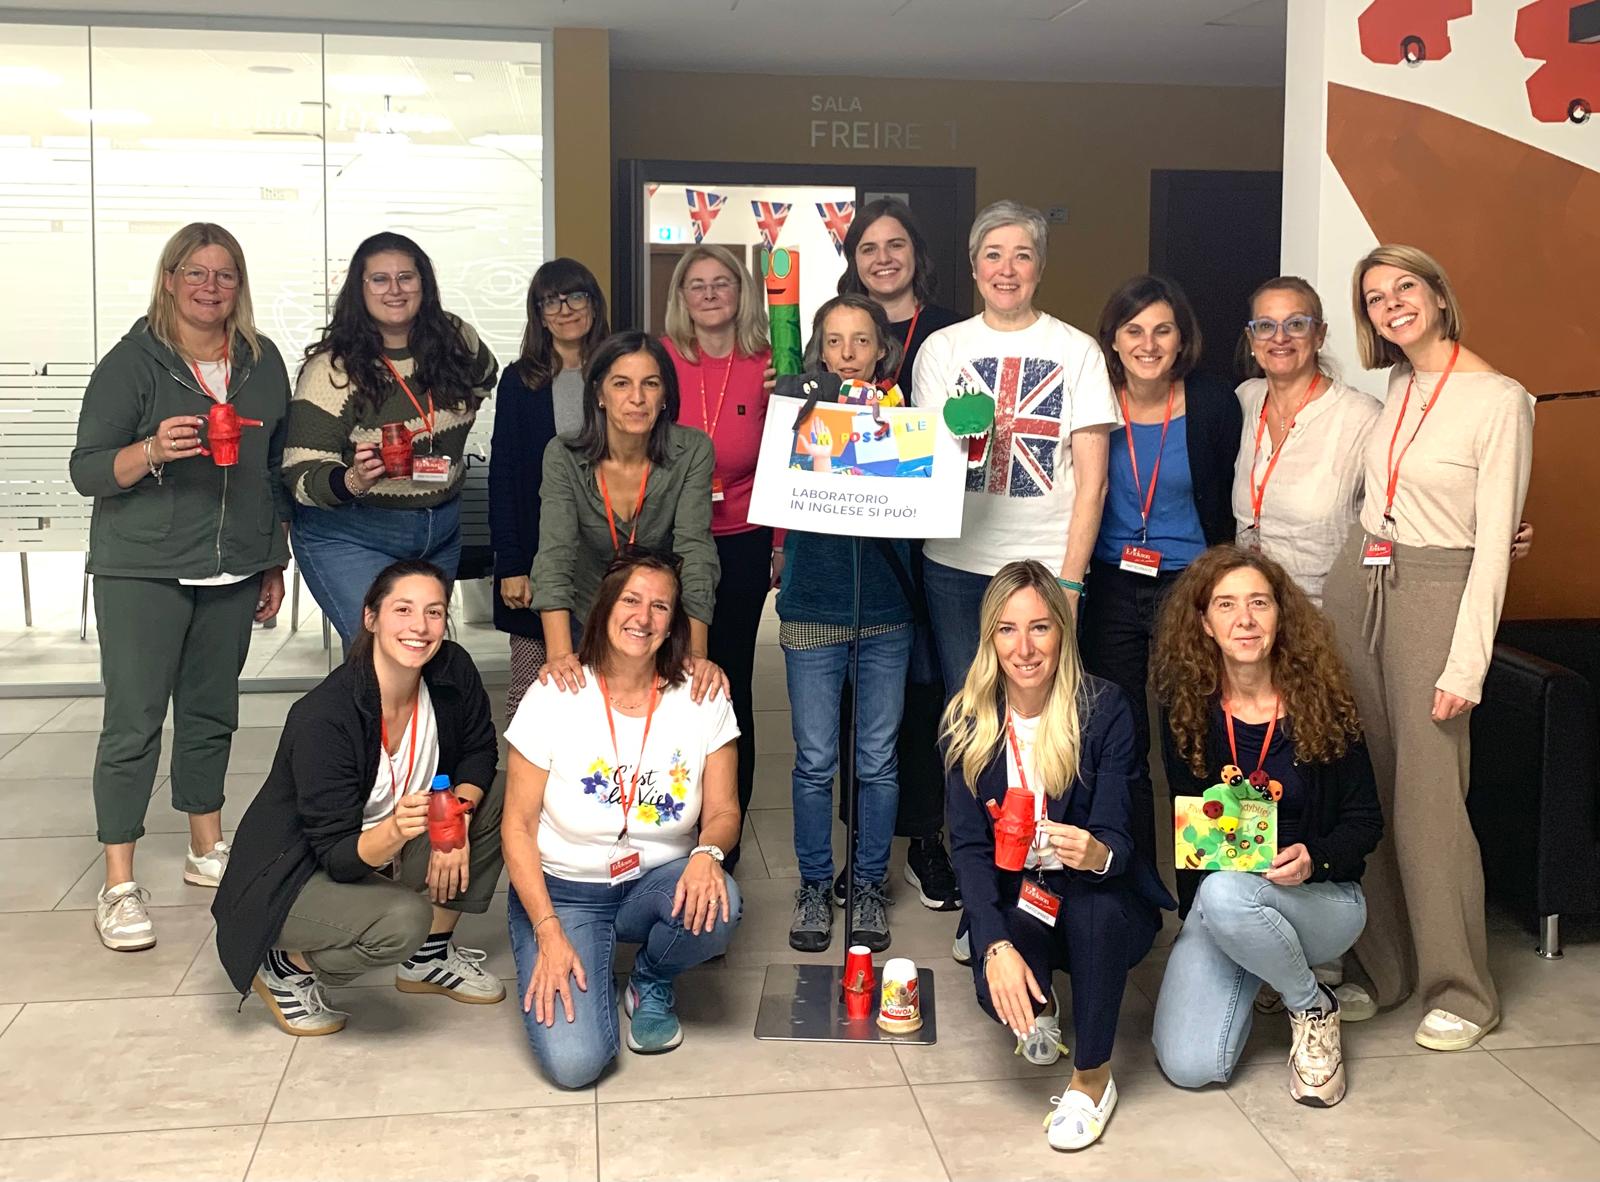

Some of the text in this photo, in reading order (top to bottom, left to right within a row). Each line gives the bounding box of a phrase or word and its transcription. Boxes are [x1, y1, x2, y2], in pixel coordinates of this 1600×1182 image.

[811, 95, 863, 112] SALA
[811, 120, 921, 149] FREIRE
[792, 487, 889, 505] LABORATORIO
[790, 499, 917, 518] IN INGLESE SI PUÒ!
[638, 786, 665, 806] Vie
